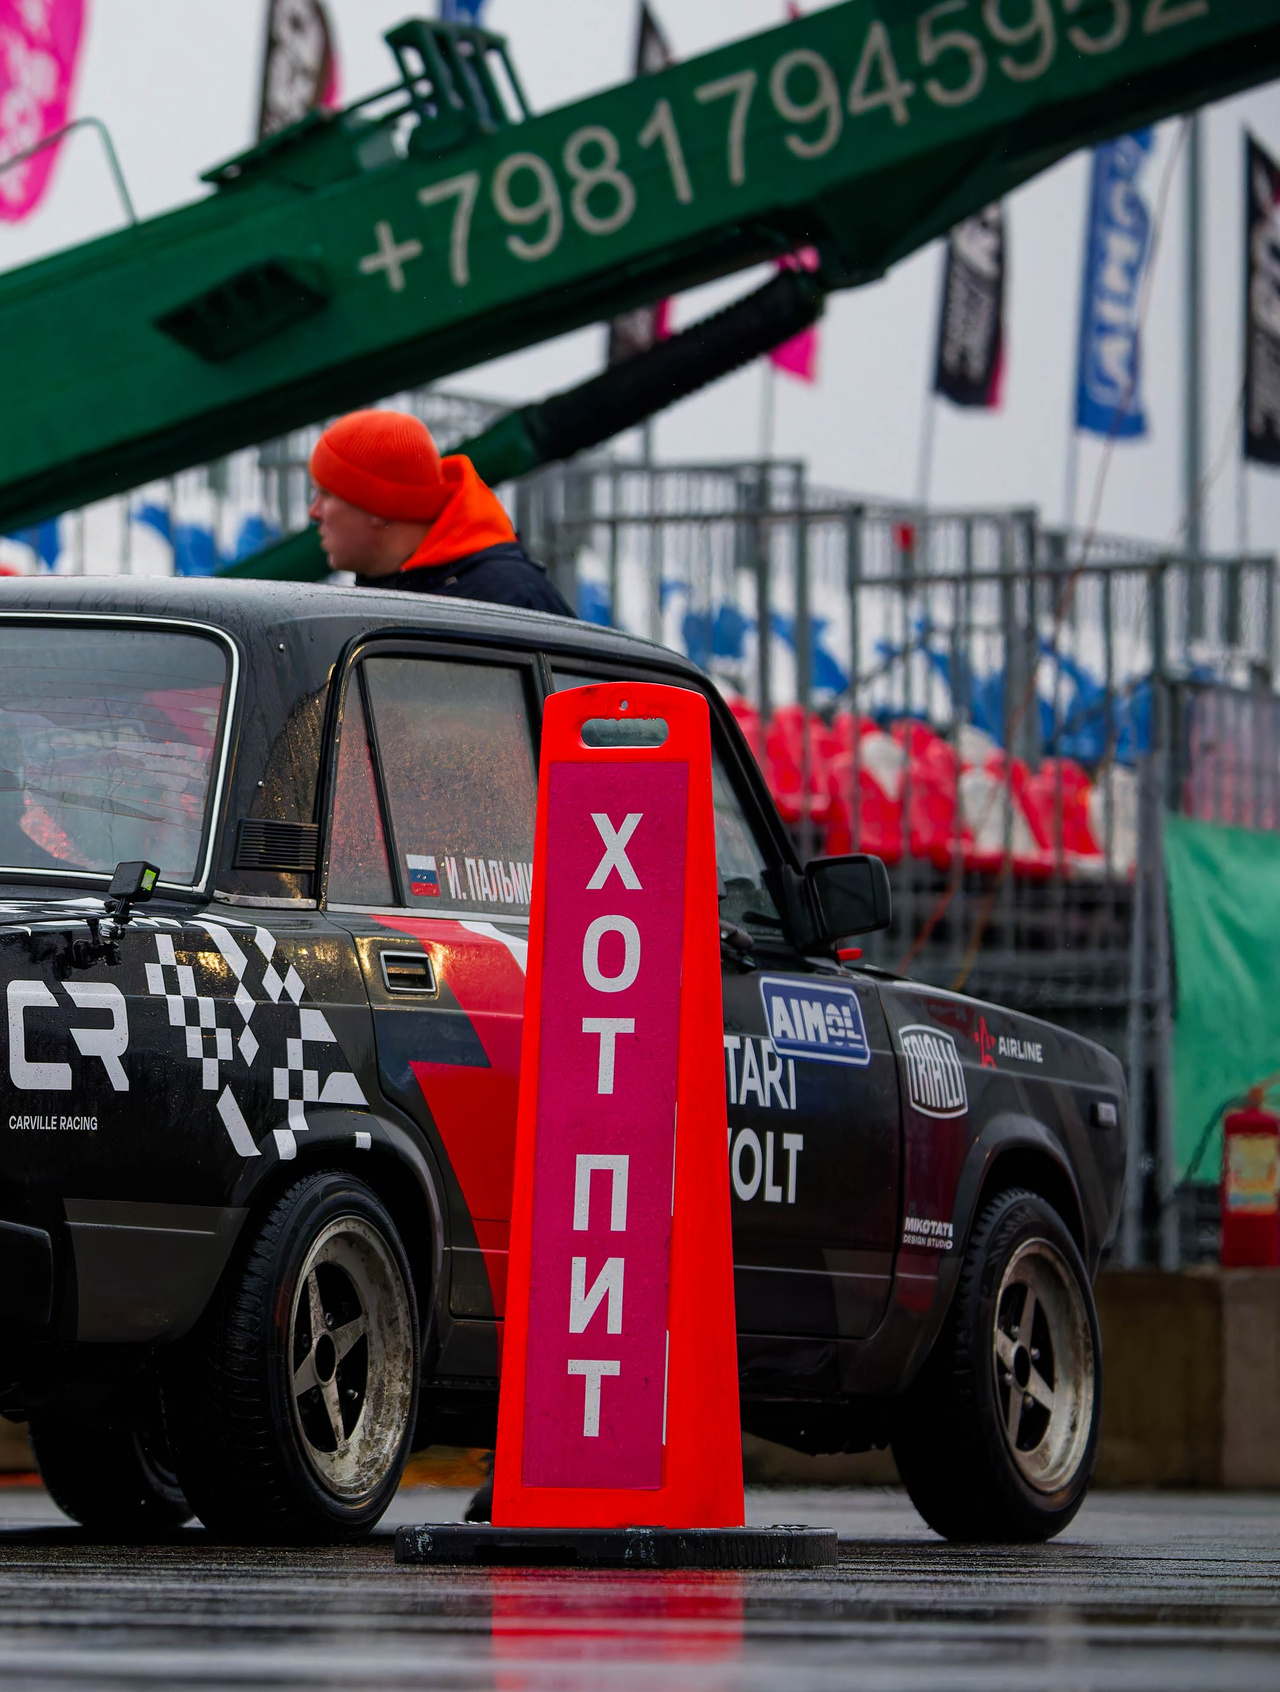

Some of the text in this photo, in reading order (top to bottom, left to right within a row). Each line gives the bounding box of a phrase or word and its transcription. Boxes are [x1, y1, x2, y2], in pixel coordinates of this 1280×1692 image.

[7, 979, 130, 1092] CR
[771, 995, 864, 1049] AIMOL
[998, 1036, 1044, 1064] AIRLINE
[903, 1033, 965, 1109] TRIALLI
[8, 1115, 98, 1131] CARVILLE RACING
[567, 812, 645, 1437] ХОТ ПИТ
[727, 1127, 804, 1204] OLT
